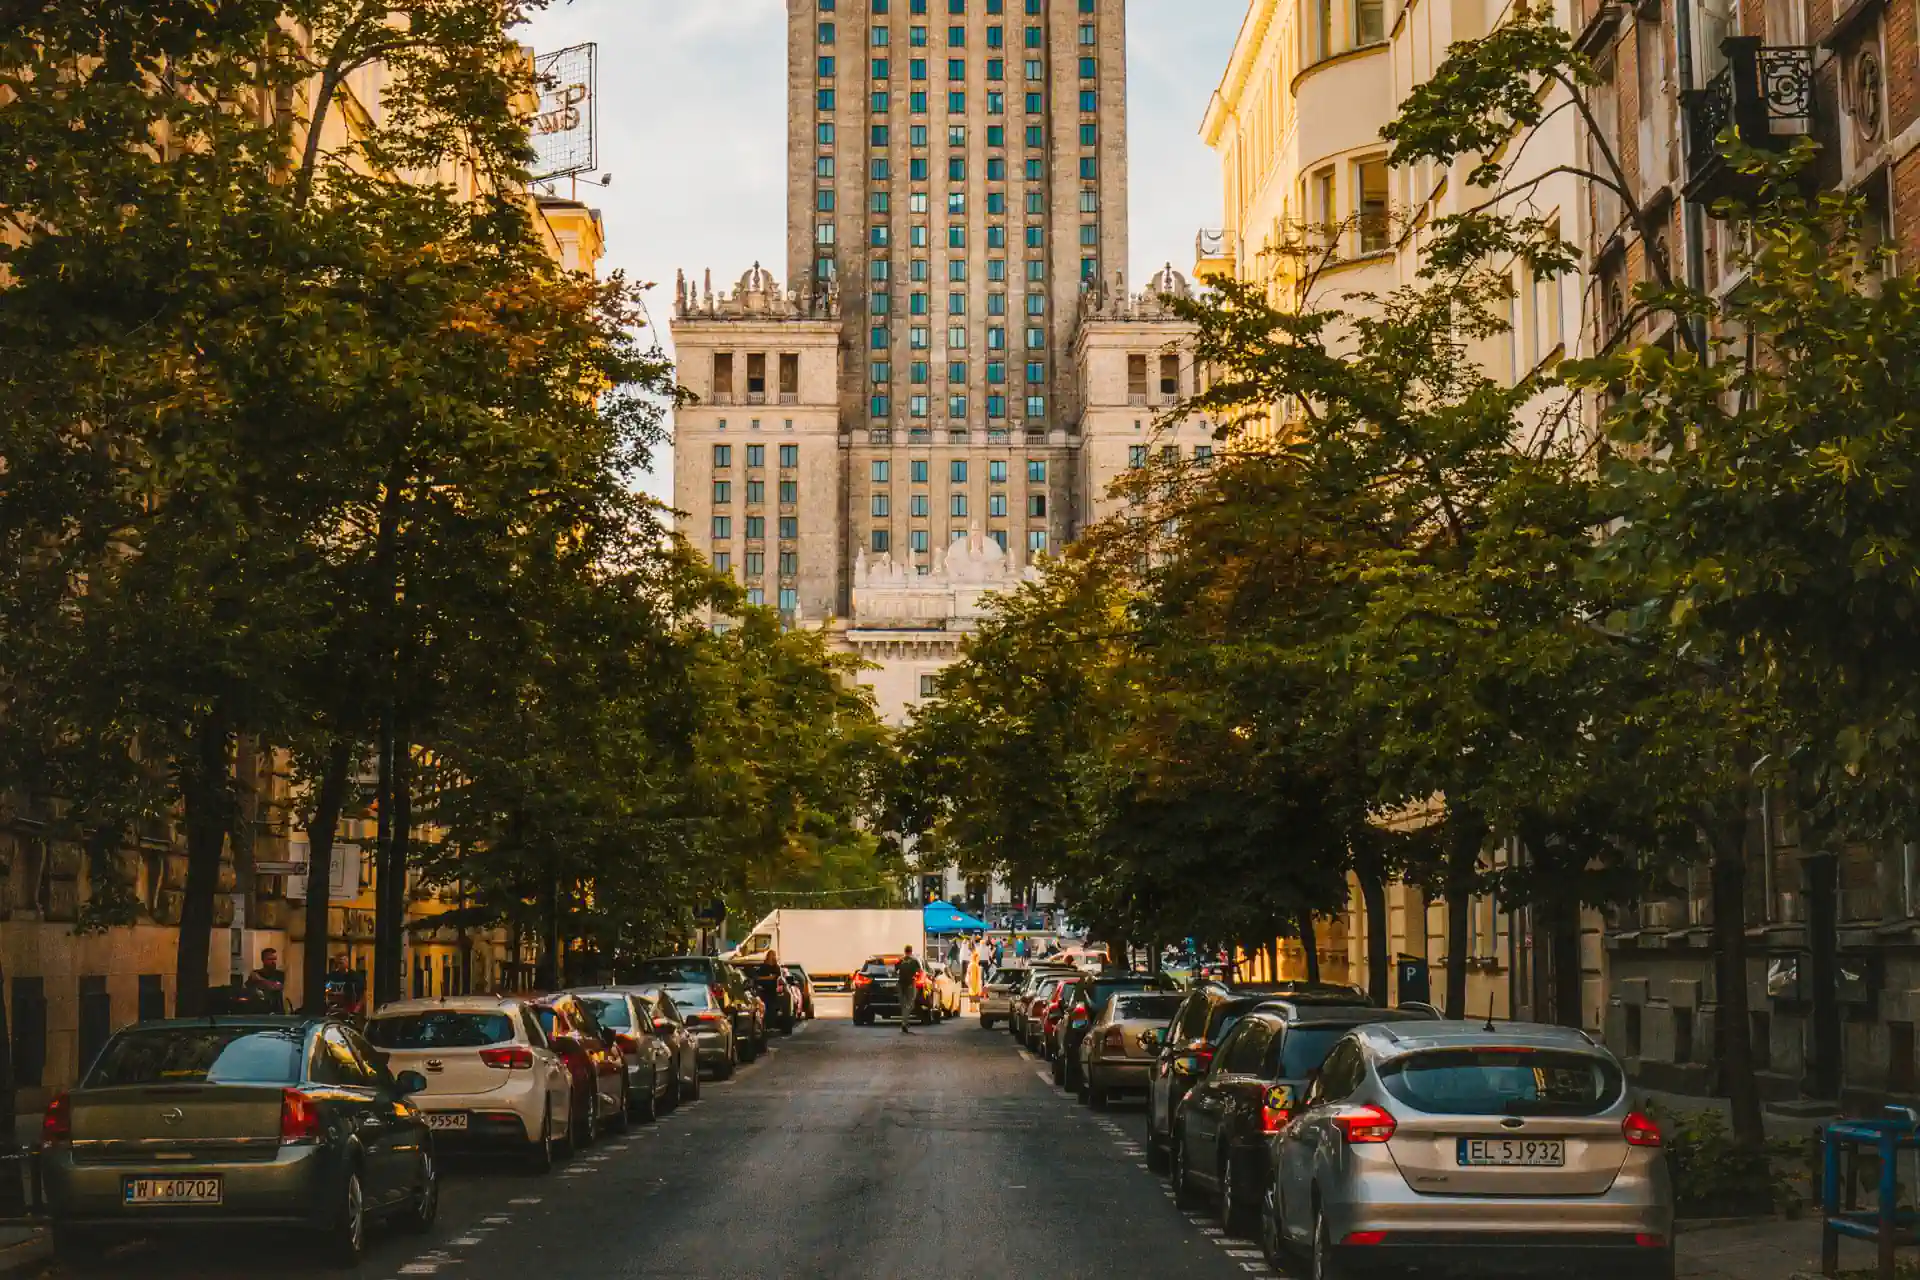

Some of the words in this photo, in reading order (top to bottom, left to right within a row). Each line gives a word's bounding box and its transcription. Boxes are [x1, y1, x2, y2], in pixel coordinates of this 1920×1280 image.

[1407, 967, 1416, 981] P
[430, 1114, 466, 1127] 95542
[1471, 1141, 1495, 1159] EL
[1503, 1141, 1560, 1160] 5J932
